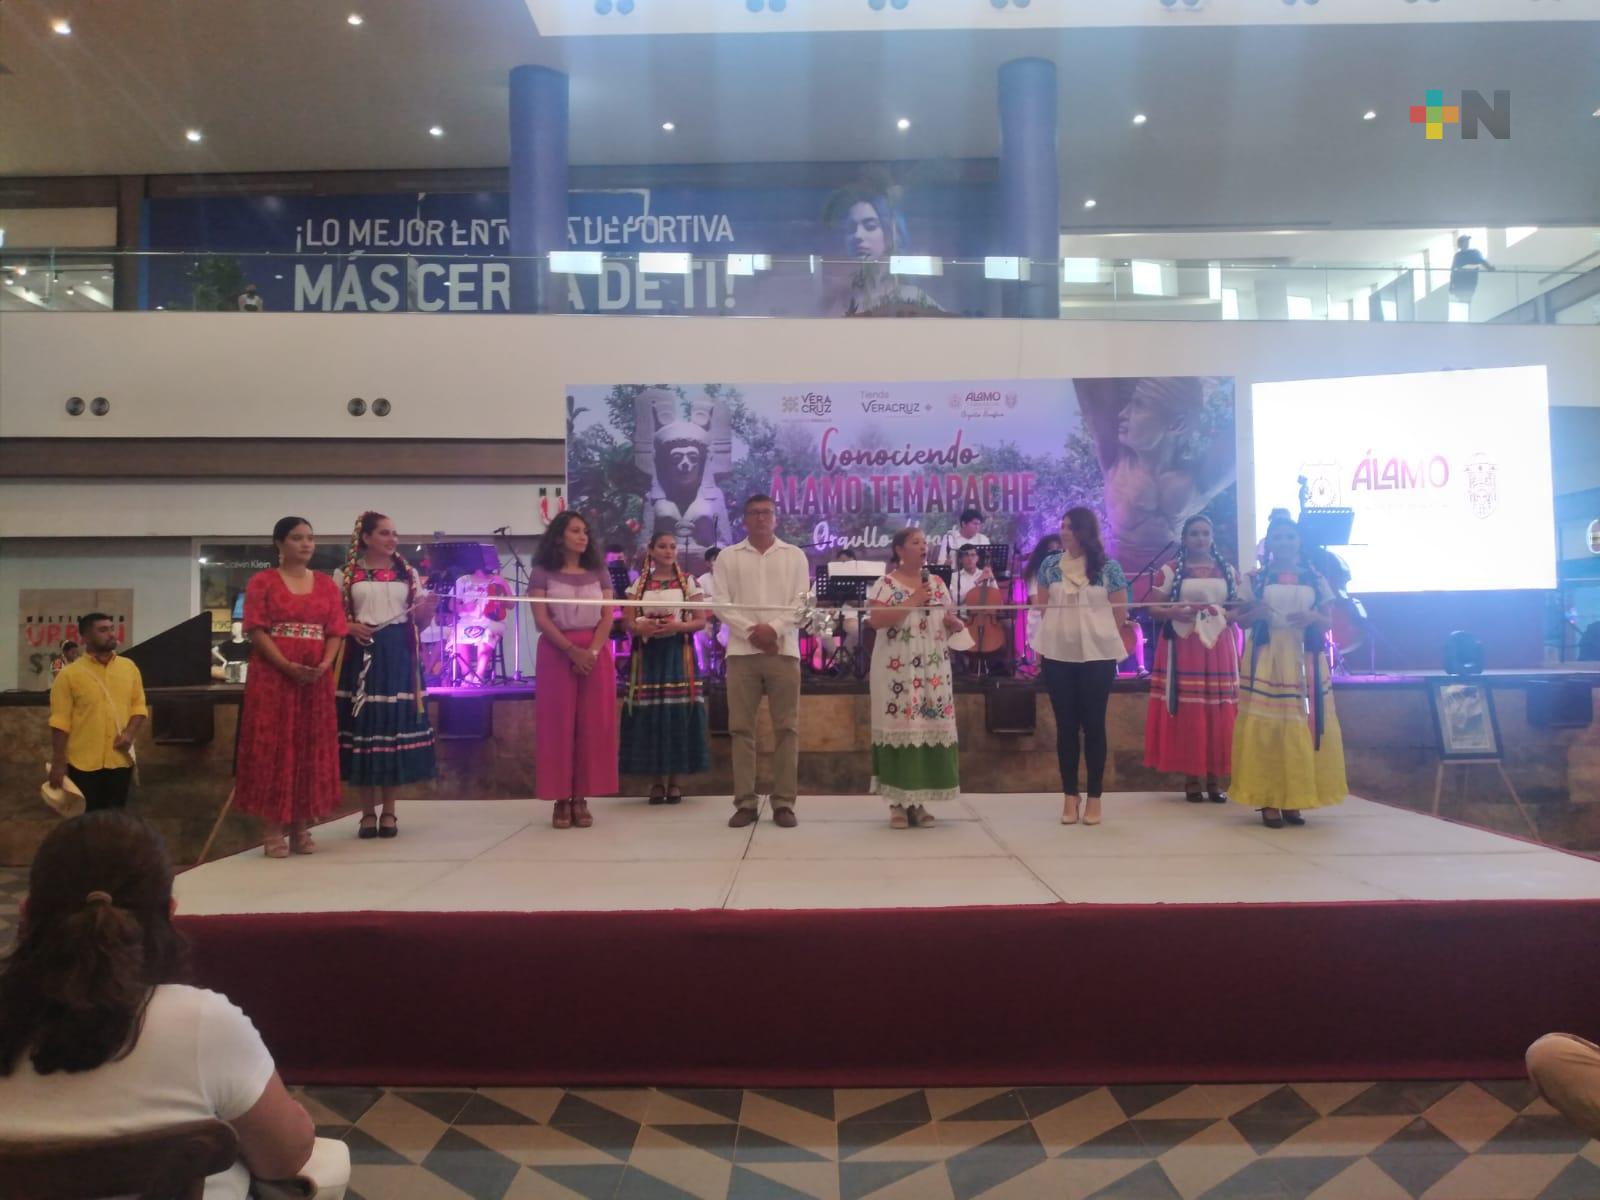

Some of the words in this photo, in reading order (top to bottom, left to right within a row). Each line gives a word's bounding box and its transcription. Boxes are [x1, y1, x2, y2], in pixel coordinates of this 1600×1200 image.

[296, 218, 339, 252] ¡LO
[349, 218, 445, 246] MEJOR
[294, 250, 399, 312] MÁS
[599, 261, 663, 310] DE
[801, 392, 832, 404] VERA
[801, 404, 832, 416] CRUZ
[861, 400, 920, 414] VERACRUZ
[820, 427, 980, 471] Conociendo
[1351, 448, 1449, 491] ÁLAMO
[770, 466, 864, 515] ÁLAMO
[869, 472, 1038, 514] TEMAPACHE
[813, 520, 893, 551] Orgullo
